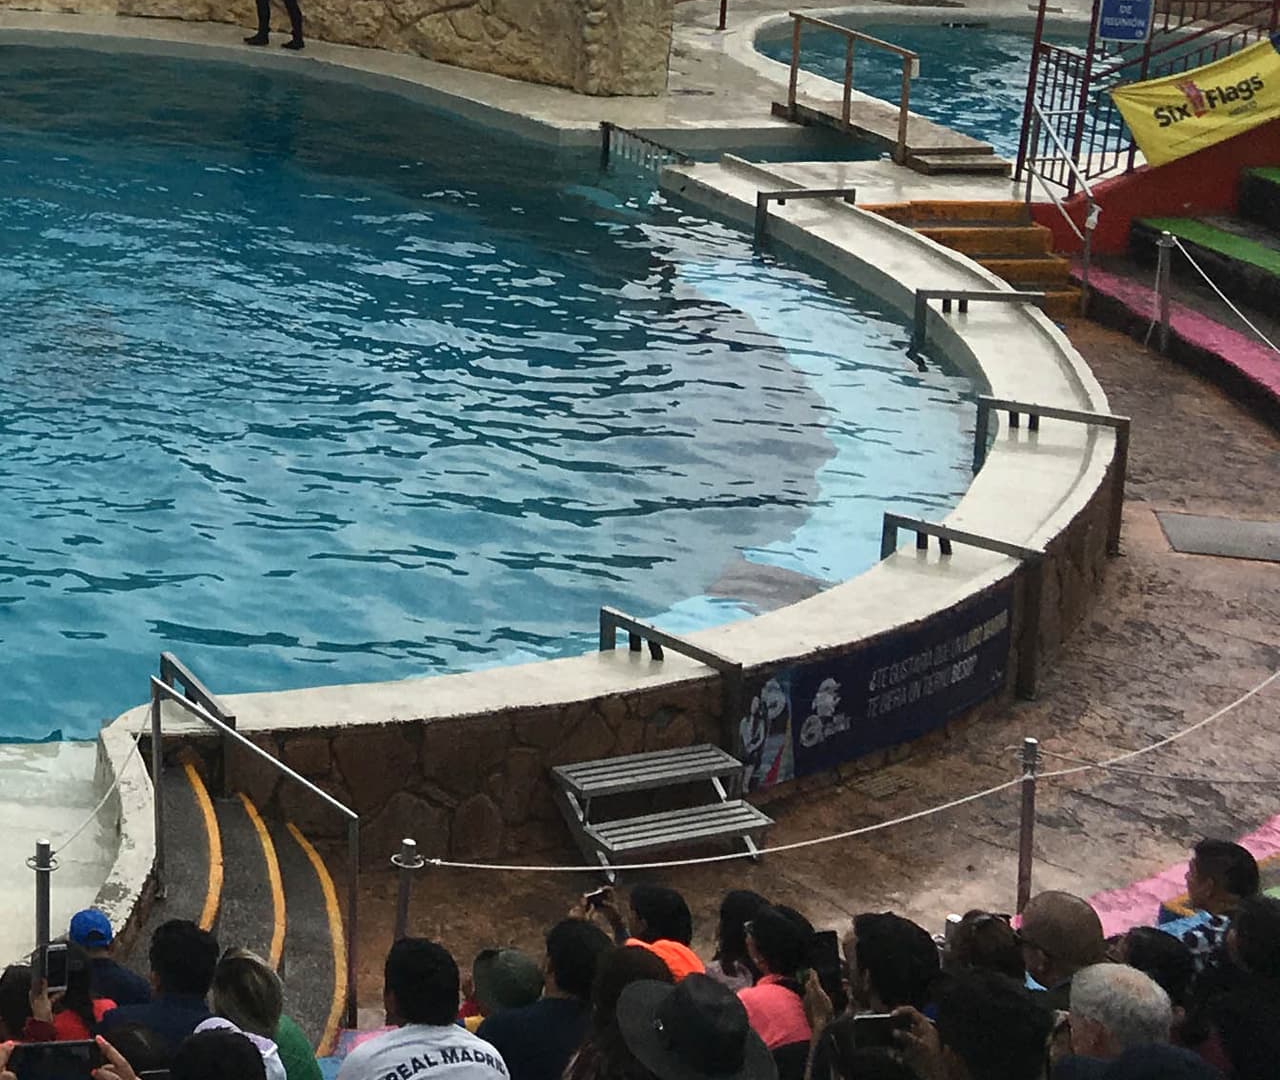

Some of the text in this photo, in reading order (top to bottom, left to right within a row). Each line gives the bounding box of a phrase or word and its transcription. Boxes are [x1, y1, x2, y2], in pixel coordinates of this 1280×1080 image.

[1119, 5, 1133, 15] DE
[1153, 103, 1192, 128] Six
[1205, 75, 1265, 109] Flags
